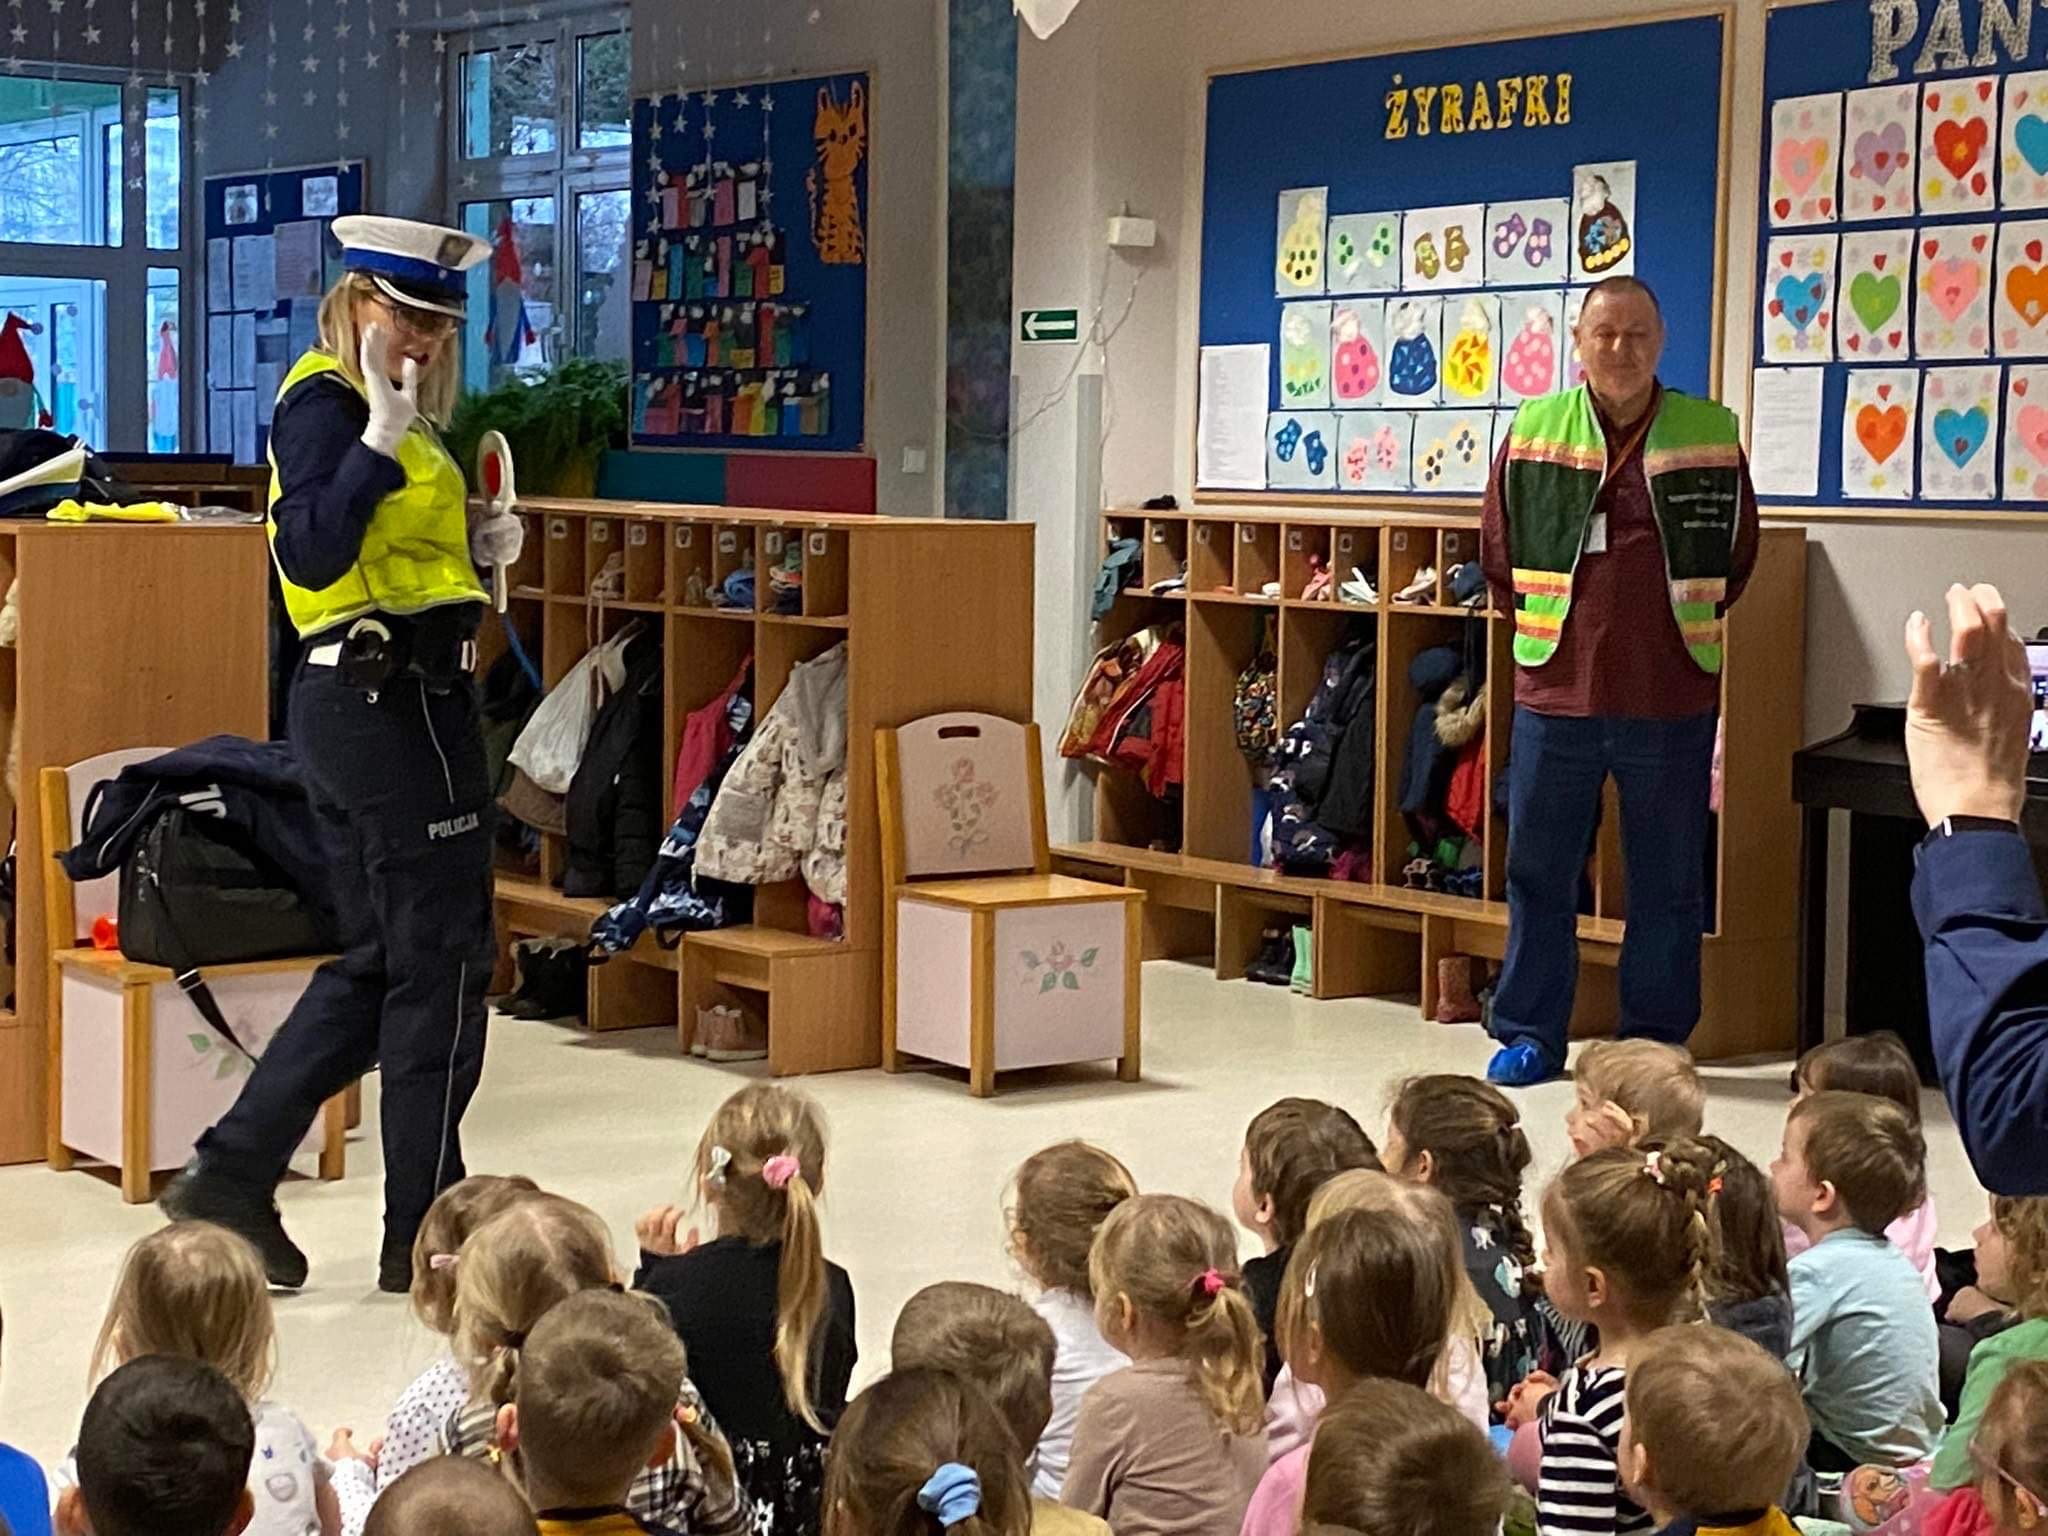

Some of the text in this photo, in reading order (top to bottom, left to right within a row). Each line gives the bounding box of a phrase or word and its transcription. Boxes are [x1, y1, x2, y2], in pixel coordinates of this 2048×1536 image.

[1867, 0, 2048, 82] PAN
[1385, 73, 1572, 139] ŻYRAFKI
[427, 812, 480, 840] POLICJA
